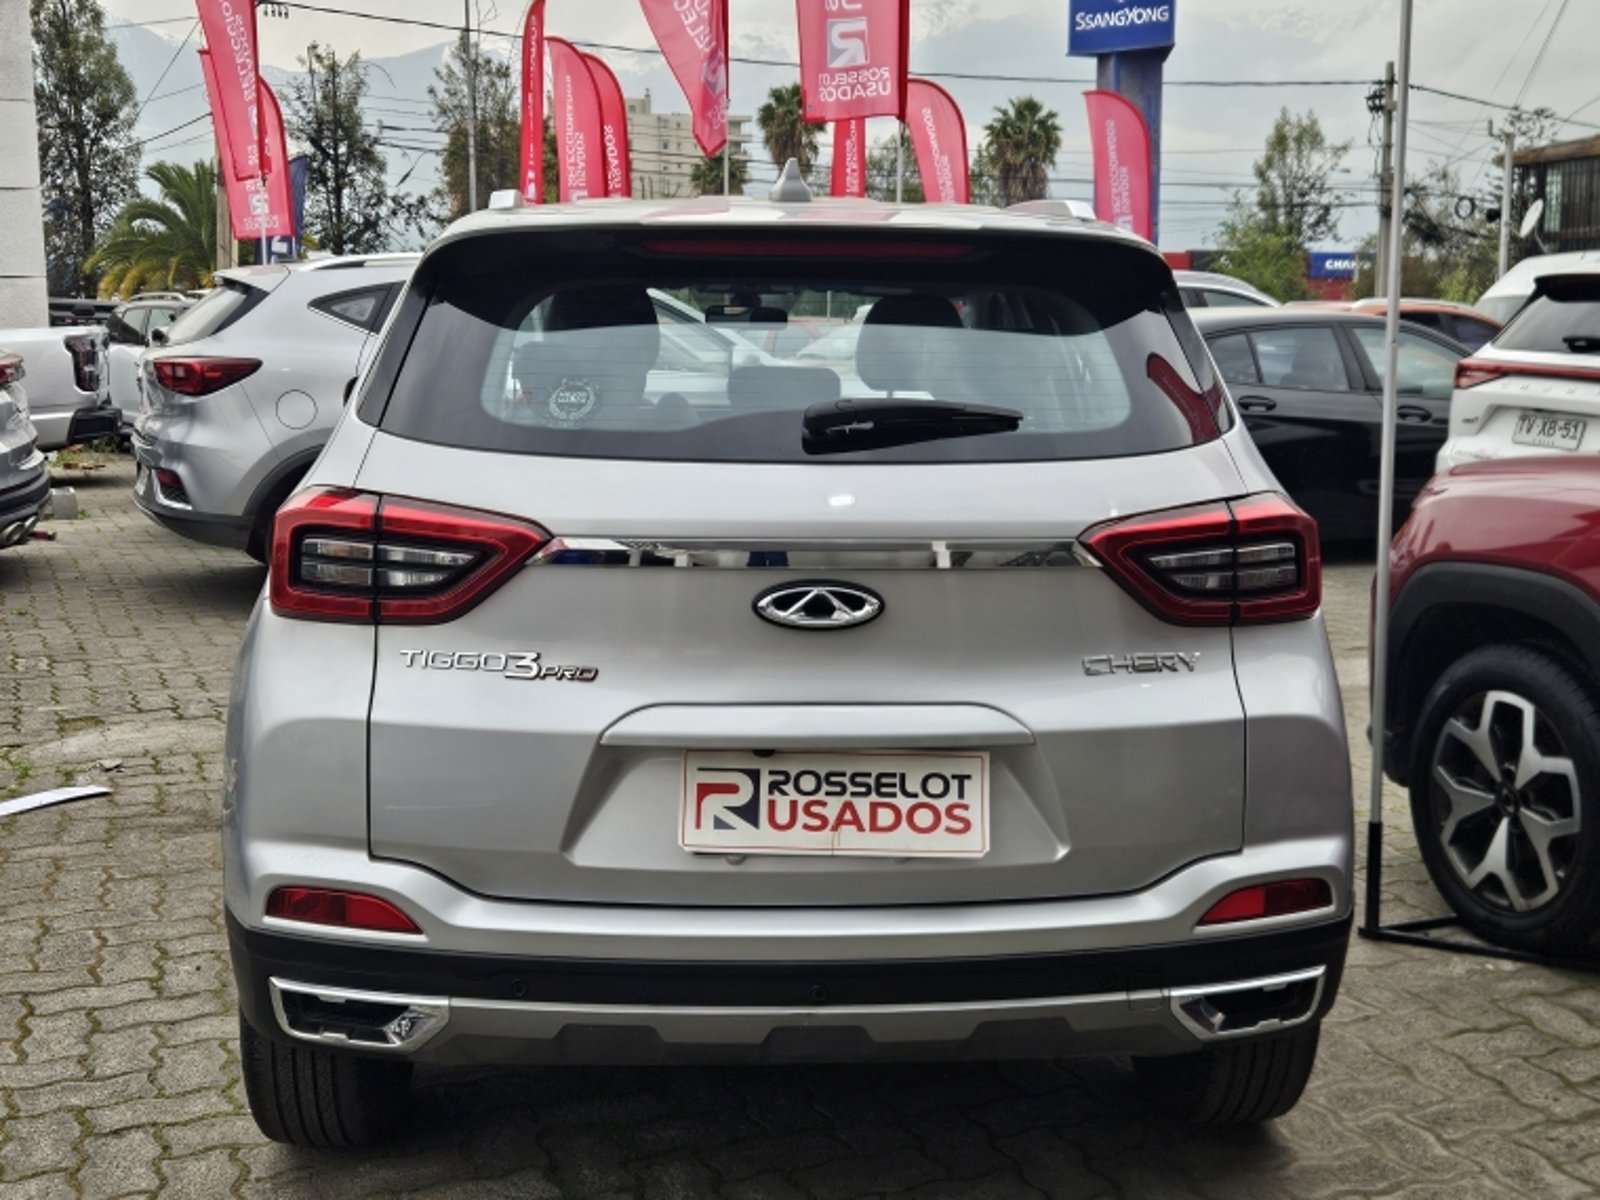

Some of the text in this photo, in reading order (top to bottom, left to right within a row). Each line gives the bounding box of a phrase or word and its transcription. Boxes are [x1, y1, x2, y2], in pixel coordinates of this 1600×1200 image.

[1075, 5, 1170, 31] SSANGYONG
[1082, 652, 1201, 676] CHERY
[767, 769, 972, 801] ROSSELOT
[767, 799, 973, 835] USADOS
